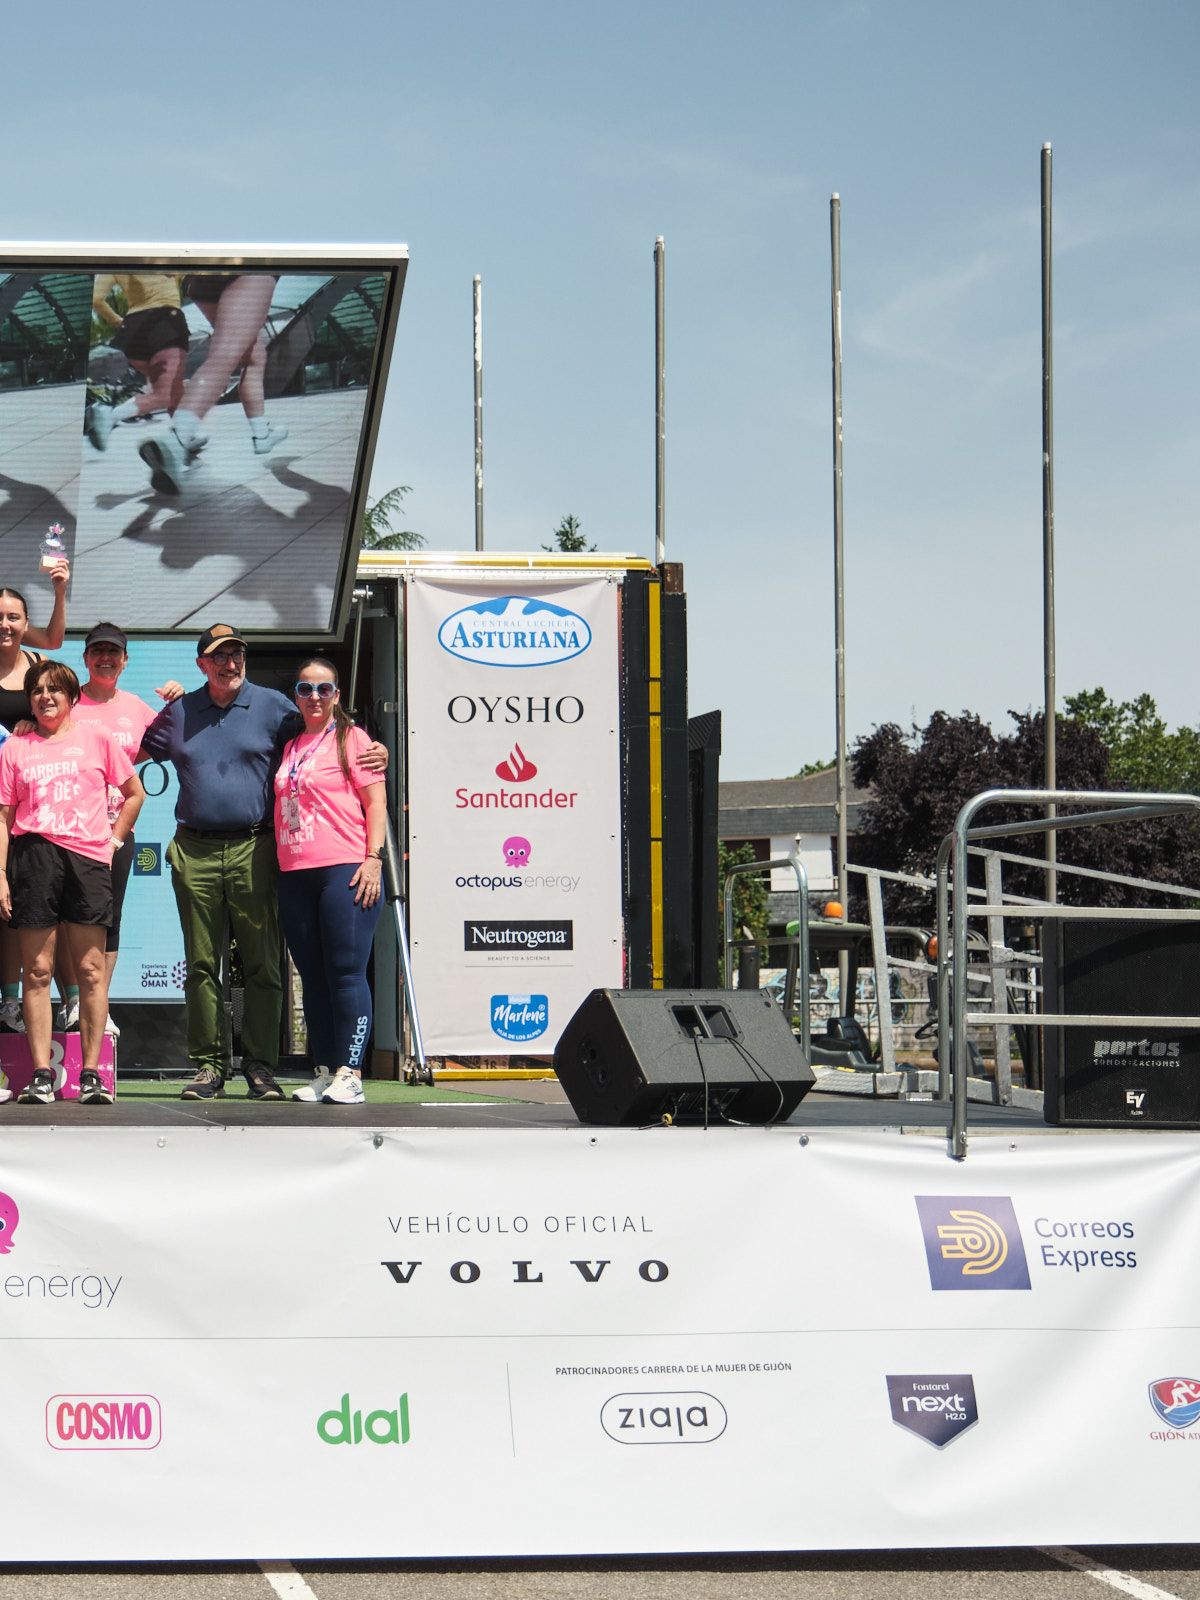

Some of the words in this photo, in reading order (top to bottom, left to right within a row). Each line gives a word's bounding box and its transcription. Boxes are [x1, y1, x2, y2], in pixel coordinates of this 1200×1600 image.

[450, 621, 581, 648] ASTURIANA
[448, 695, 584, 723] OYSHO
[23, 760, 79, 783] CARRERA
[455, 788, 578, 808] Santander
[455, 874, 522, 891] octopus
[524, 875, 581, 893] energy
[471, 926, 567, 948] Neutrogena
[141, 980, 168, 988] OMAN
[527, 1028, 541, 1039] ALPES
[1093, 1039, 1180, 1058] portos
[1126, 1091, 1145, 1108] EV
[388, 1213, 530, 1234] VEHÍCULO
[544, 1215, 654, 1234] OFICIAL
[1033, 1217, 1135, 1239] Correos
[1040, 1245, 1138, 1272] Express
[380, 1259, 670, 1284] VOLVO
[4, 1274, 123, 1309] energy
[555, 1366, 639, 1375] PATROCINADORES
[641, 1365, 684, 1374] CARRERA
[686, 1365, 699, 1373] DE
[701, 1364, 713, 1373] LA
[715, 1363, 747, 1373] MUJER
[749, 1363, 761, 1371] DE
[763, 1362, 792, 1371] GIJÓN
[912, 1383, 950, 1391] Fontarel
[901, 1393, 966, 1412] next
[56, 1401, 153, 1442] COSMO
[316, 1391, 411, 1445] dial
[618, 1405, 708, 1437] ziaja
[1150, 1428, 1186, 1441] GIJÓN
